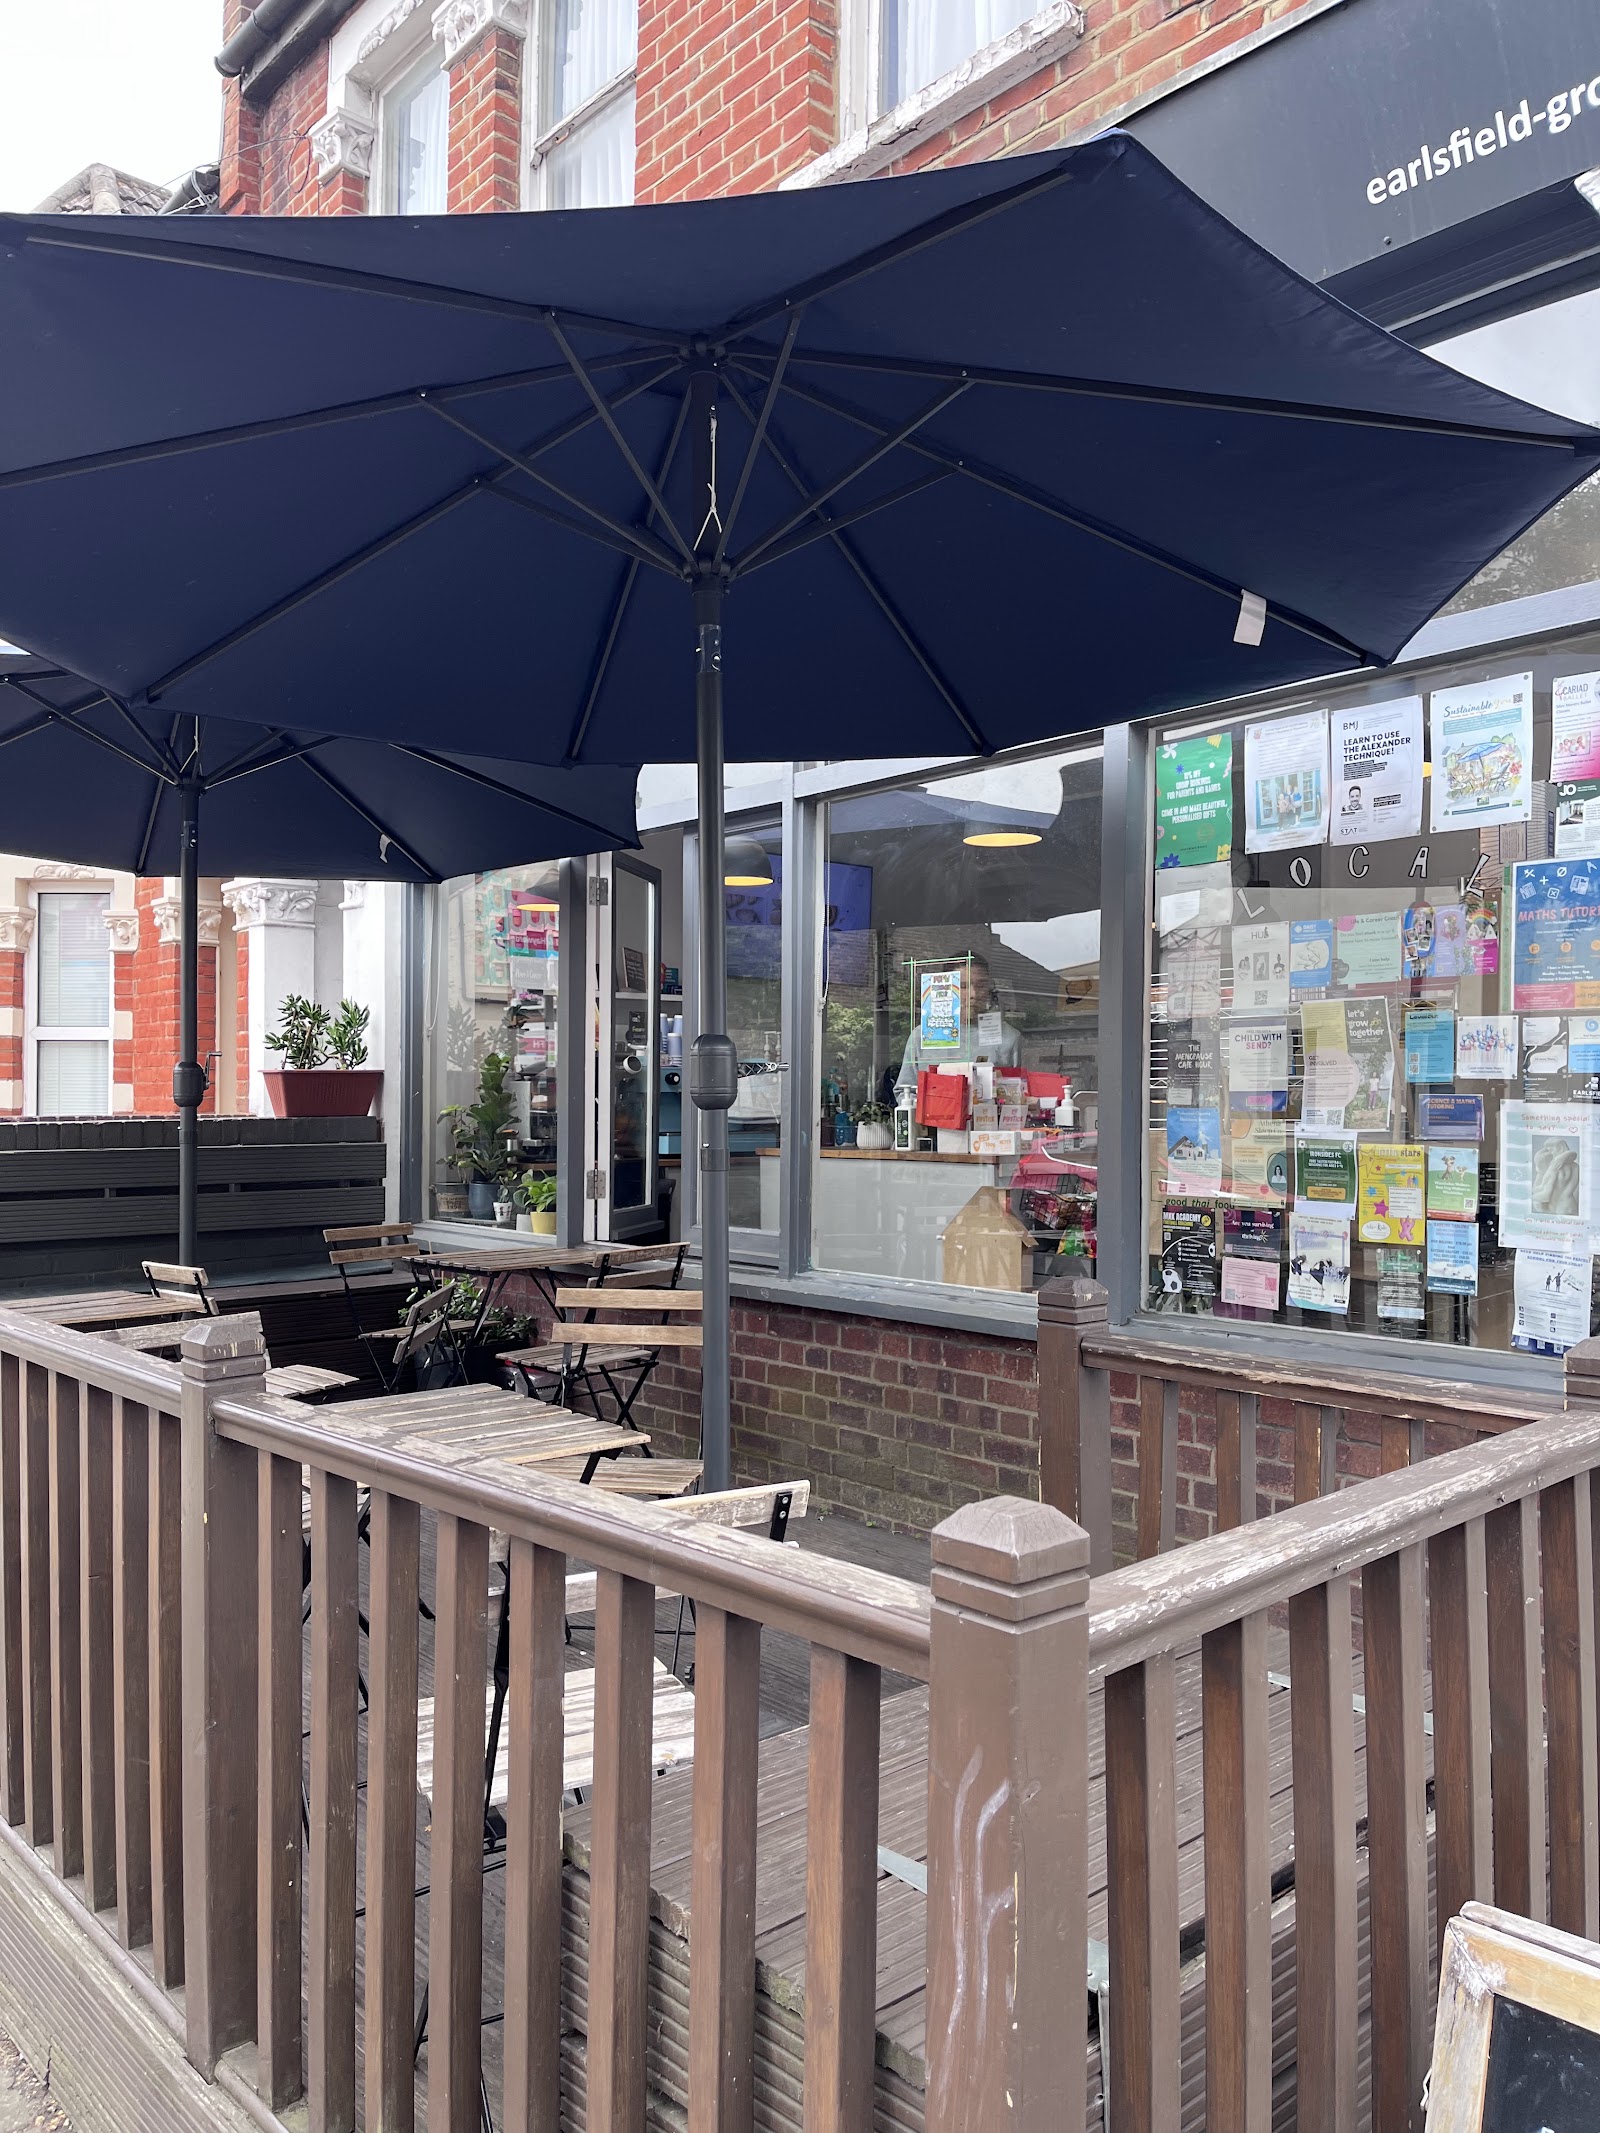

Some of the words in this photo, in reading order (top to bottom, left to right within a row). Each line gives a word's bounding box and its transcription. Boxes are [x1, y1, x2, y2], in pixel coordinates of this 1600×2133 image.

[1562, 683, 1589, 695] CARIAD
[1563, 692, 1588, 701] BALLET
[1444, 700, 1493, 718] Sustainable
[1343, 720, 1359, 731] BMJ
[1344, 736, 1370, 746] LEARN
[1372, 734, 1383, 742] TO
[1385, 730, 1400, 739] USE
[1344, 746, 1360, 754] THE
[1361, 737, 1411, 751] ALEXANDER
[1344, 747, 1394, 762] TECHNIQUE!
[1559, 784, 1577, 796] JO
[1519, 909, 1557, 922] MATHS
[1347, 1010, 1365, 1018] let's
[1347, 1019, 1369, 1029] grow
[1235, 1034, 1260, 1042] CHILD
[1262, 1033, 1282, 1041] WITH
[1349, 1028, 1384, 1038] together
[1188, 1044, 1200, 1052] THE
[1175, 1053, 1213, 1061] MENOPAUSE
[1521, 1113, 1561, 1123] Something
[1310, 1150, 1334, 1158] IRONSIDES
[1400, 1148, 1421, 1157] stars
[1192, 1199, 1210, 1208] thai
[1176, 1213, 1201, 1222] ACADEMY
